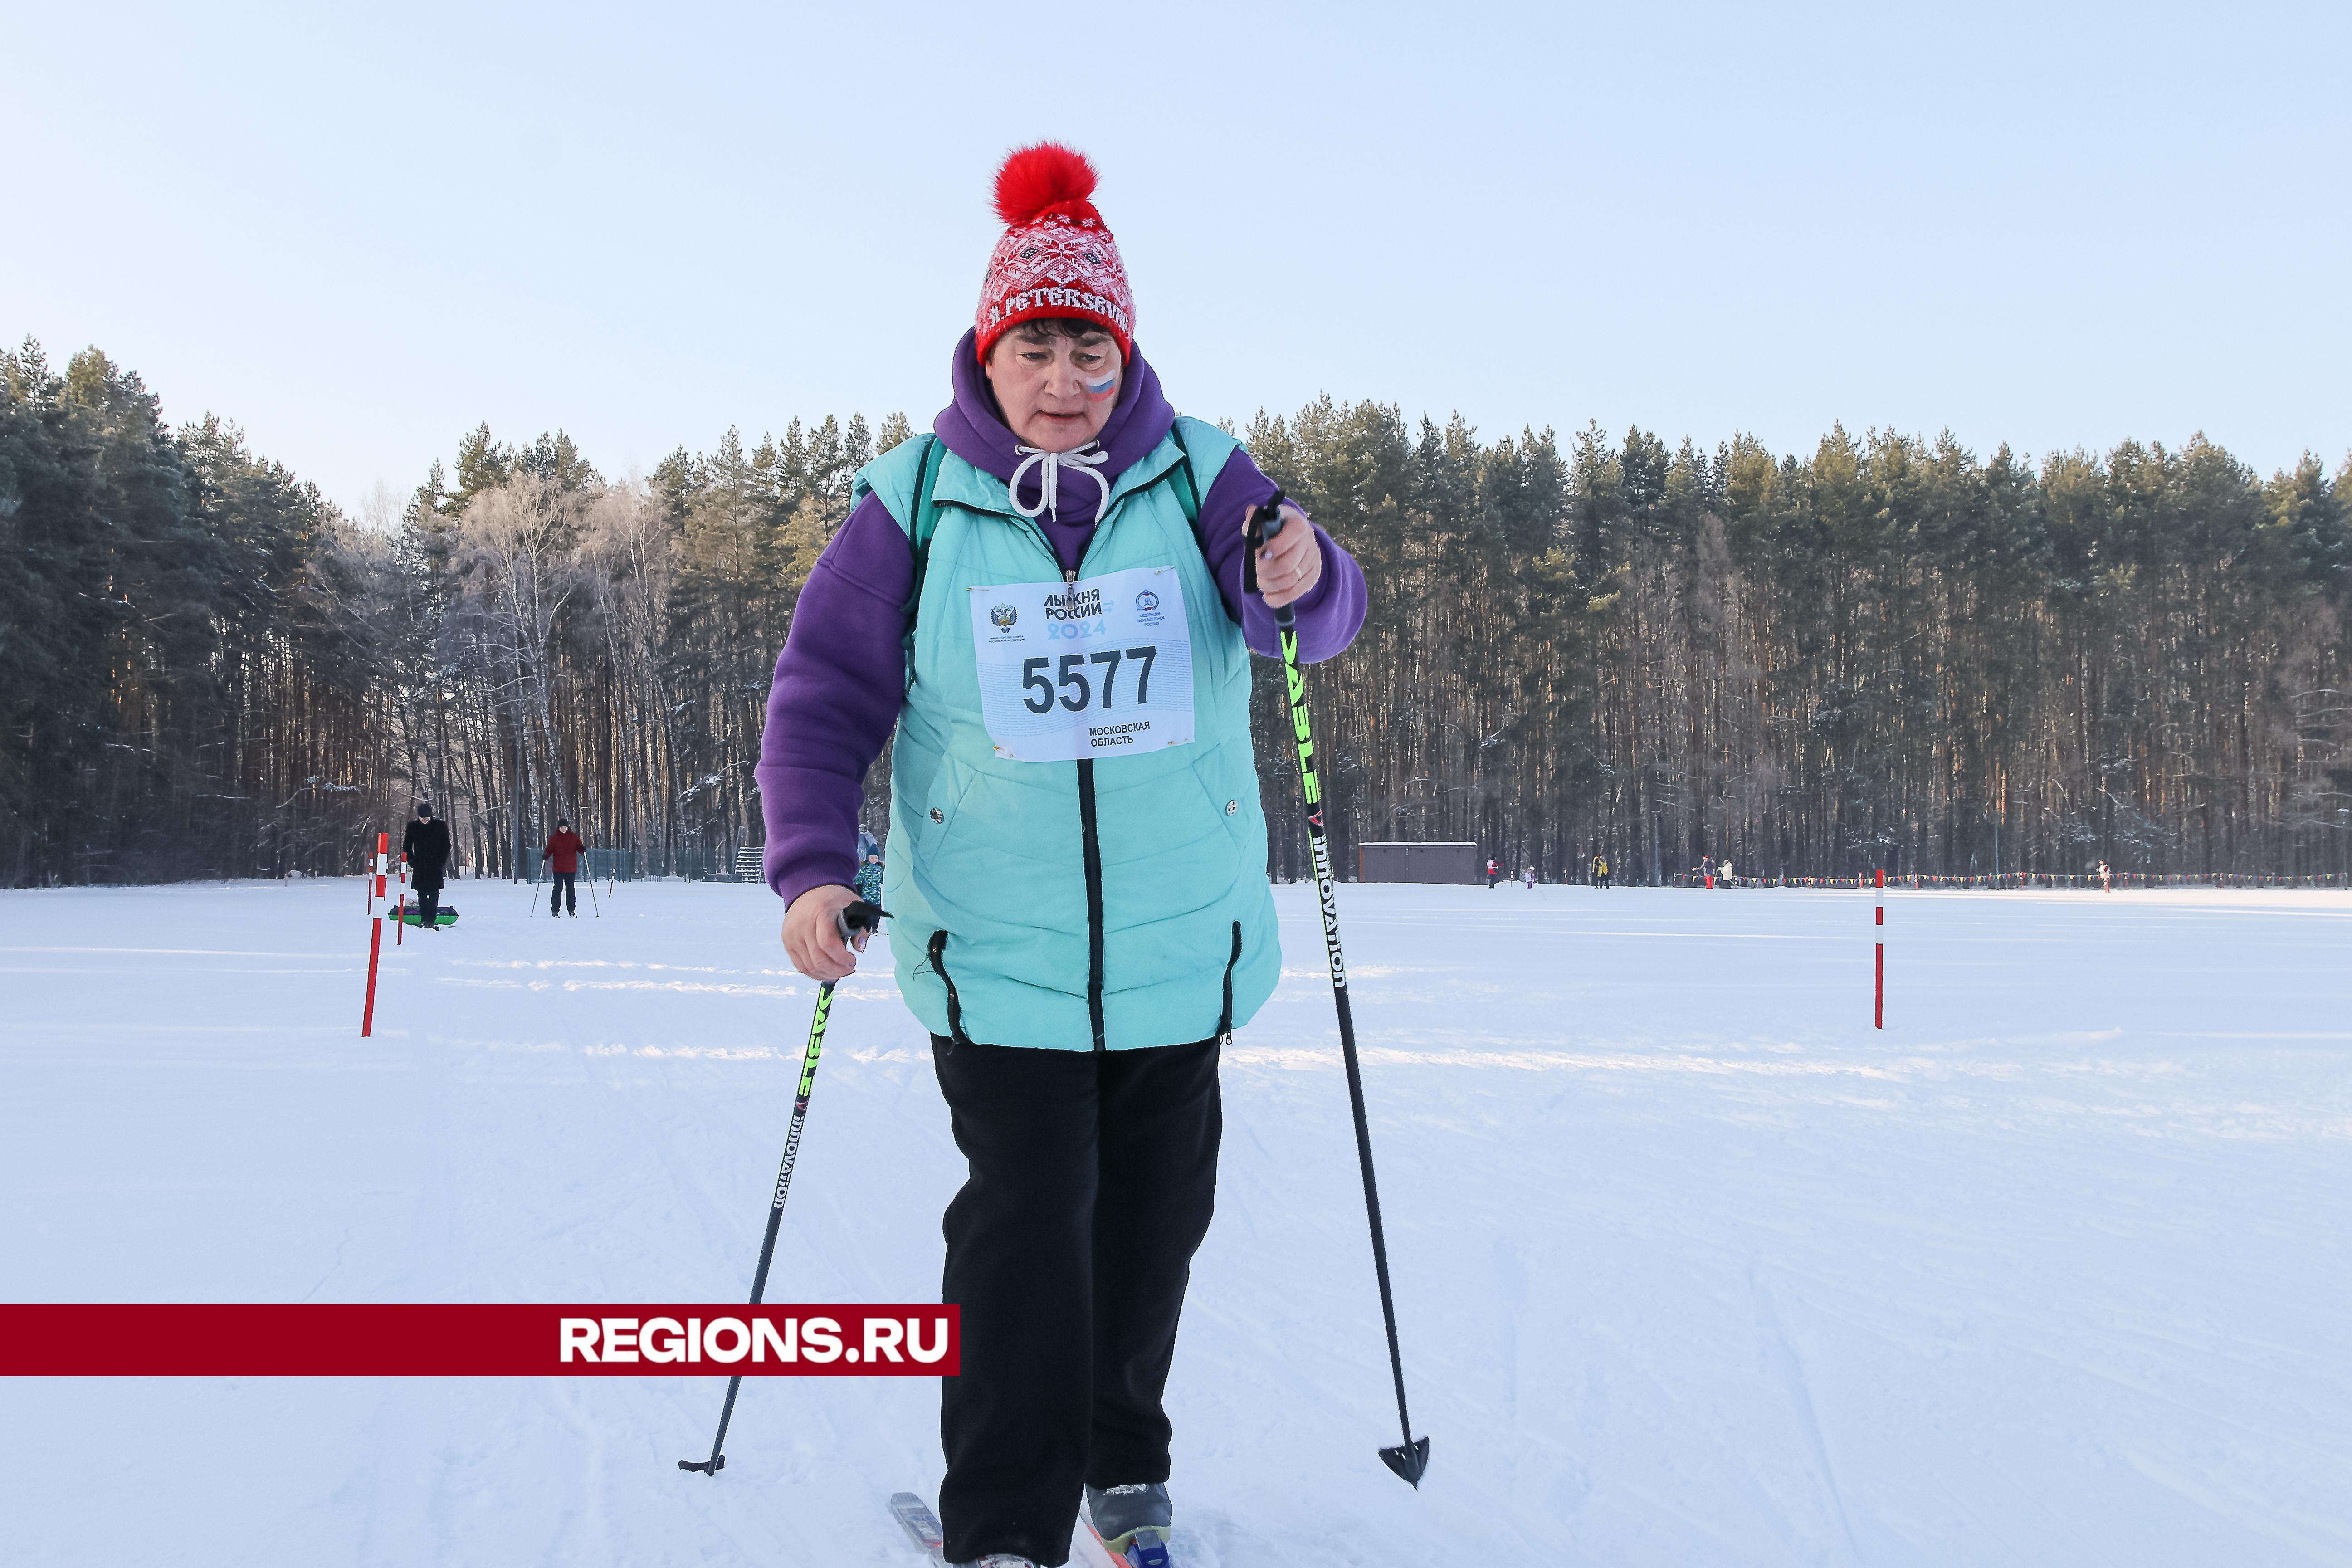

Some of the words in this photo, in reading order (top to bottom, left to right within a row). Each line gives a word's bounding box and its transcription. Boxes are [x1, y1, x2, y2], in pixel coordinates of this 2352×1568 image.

[1045, 602, 1102, 620] РОССИИ
[1047, 619, 1106, 640] 2024
[1023, 646, 1156, 714] 5577
[1089, 721, 1150, 736] МОСКОВСКАЯ
[1091, 736, 1133, 747] ОБЛАСТЬ
